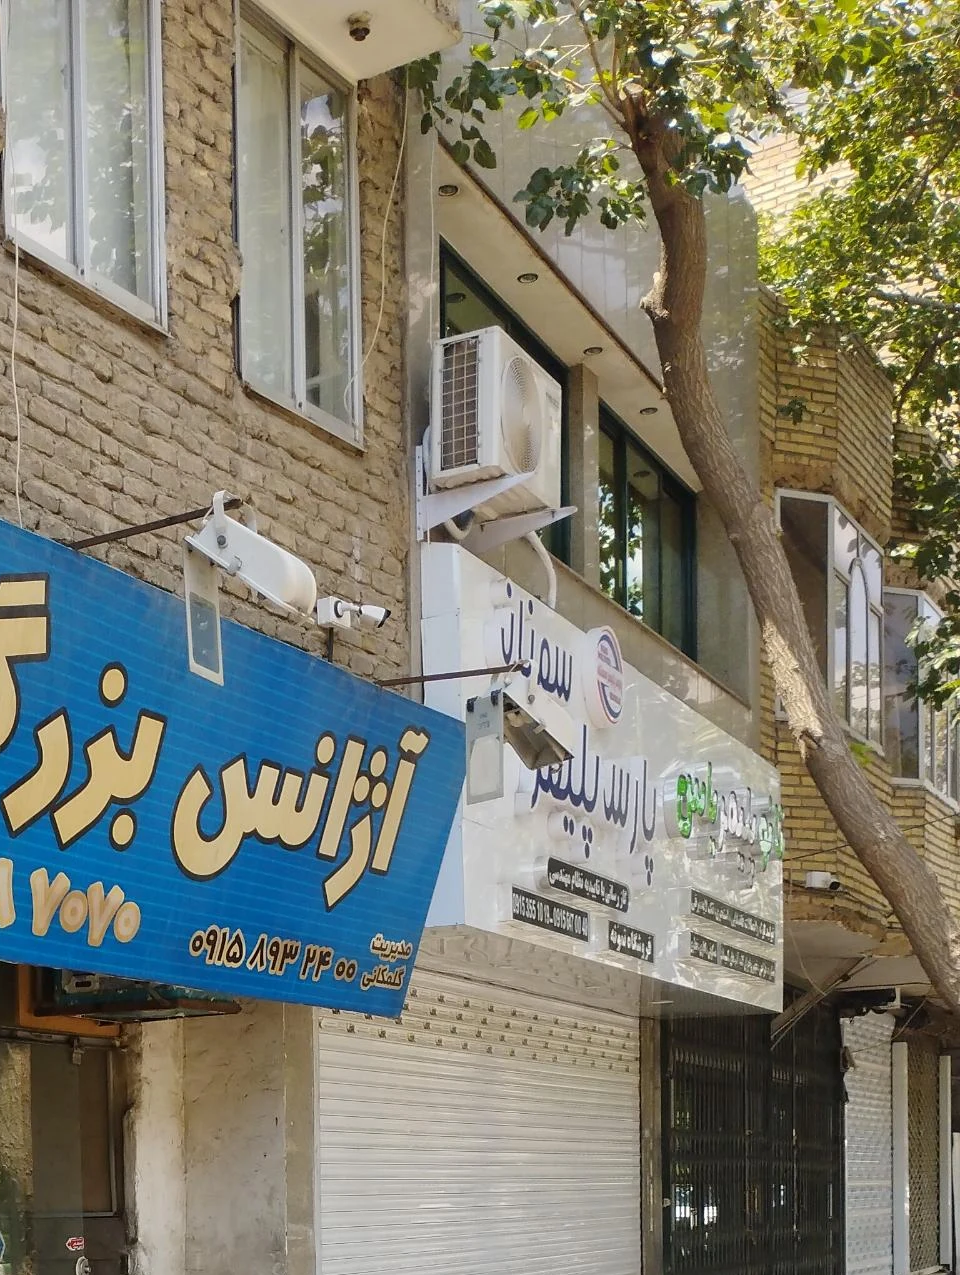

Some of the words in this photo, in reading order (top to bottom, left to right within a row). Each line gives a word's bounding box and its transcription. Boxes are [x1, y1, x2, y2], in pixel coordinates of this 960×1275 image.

[171, 725, 430, 911] آژانس
[603, 760, 657, 886] پارس
[191, 924, 246, 968] ۰۹۱۵
[246, 933, 300, 976] ۸۹۳
[300, 943, 334, 982] ۲۴
[334, 957, 358, 982] ۰۰
[370, 933, 413, 962] مدیریت
